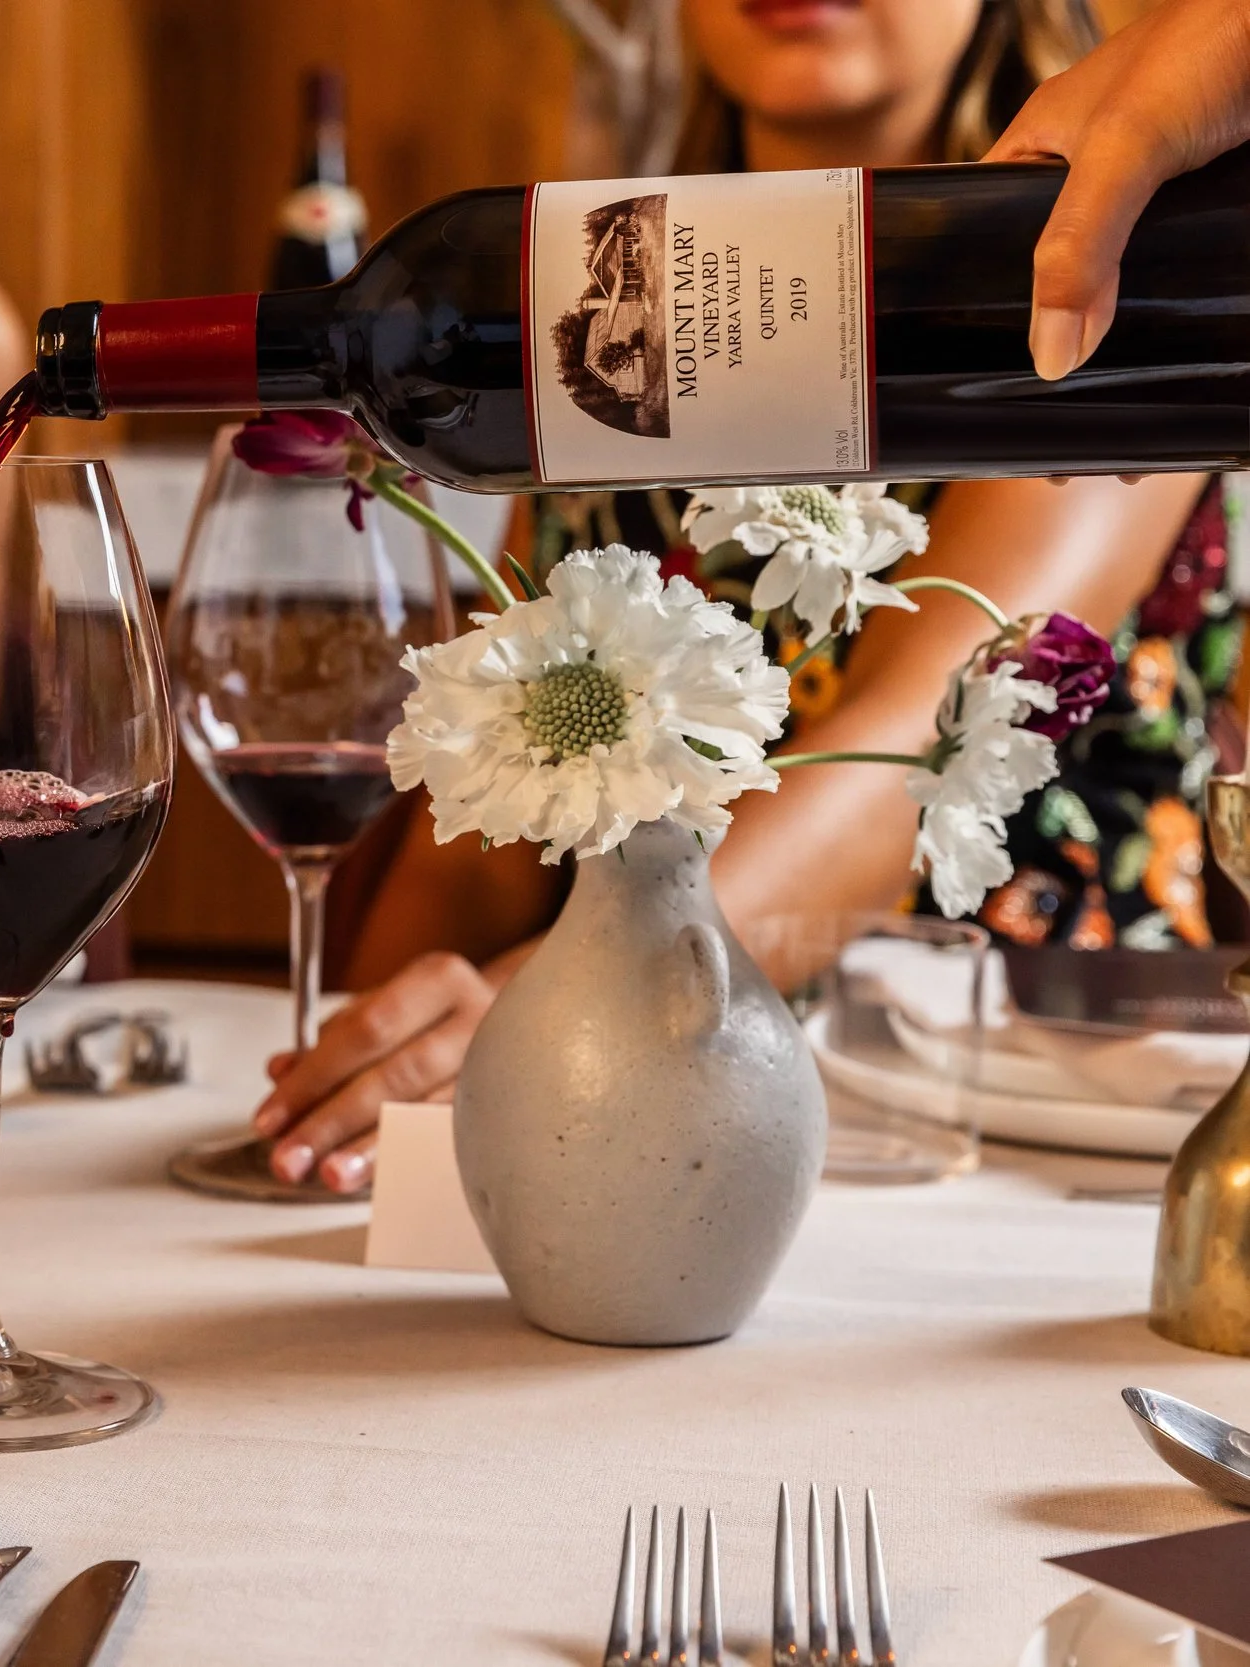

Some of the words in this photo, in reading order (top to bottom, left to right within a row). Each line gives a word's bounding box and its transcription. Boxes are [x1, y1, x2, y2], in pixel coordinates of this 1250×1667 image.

[837, 223, 846, 239] Mary
[846, 230, 855, 256] Contains
[673, 222, 695, 293] MARY
[837, 239, 845, 260] Mount
[726, 243, 741, 307] VALLEY
[837, 267, 846, 292] Bottled
[759, 264, 778, 340] QUINTET
[789, 277, 808, 322] 2019
[848, 284, 856, 296] egg
[701, 251, 720, 360] VINEYARD
[838, 293, 846, 315] Estate
[848, 297, 856, 312] with
[727, 309, 742, 369] YARRA
[838, 321, 847, 353] Australia
[848, 313, 857, 345] Produced
[674, 298, 698, 399] MOUNT
[839, 353, 847, 361] of
[839, 361, 847, 380] Wine
[850, 380, 858, 415] Coldstream
[834, 429, 849, 444] Vol
[851, 425, 859, 439] West
